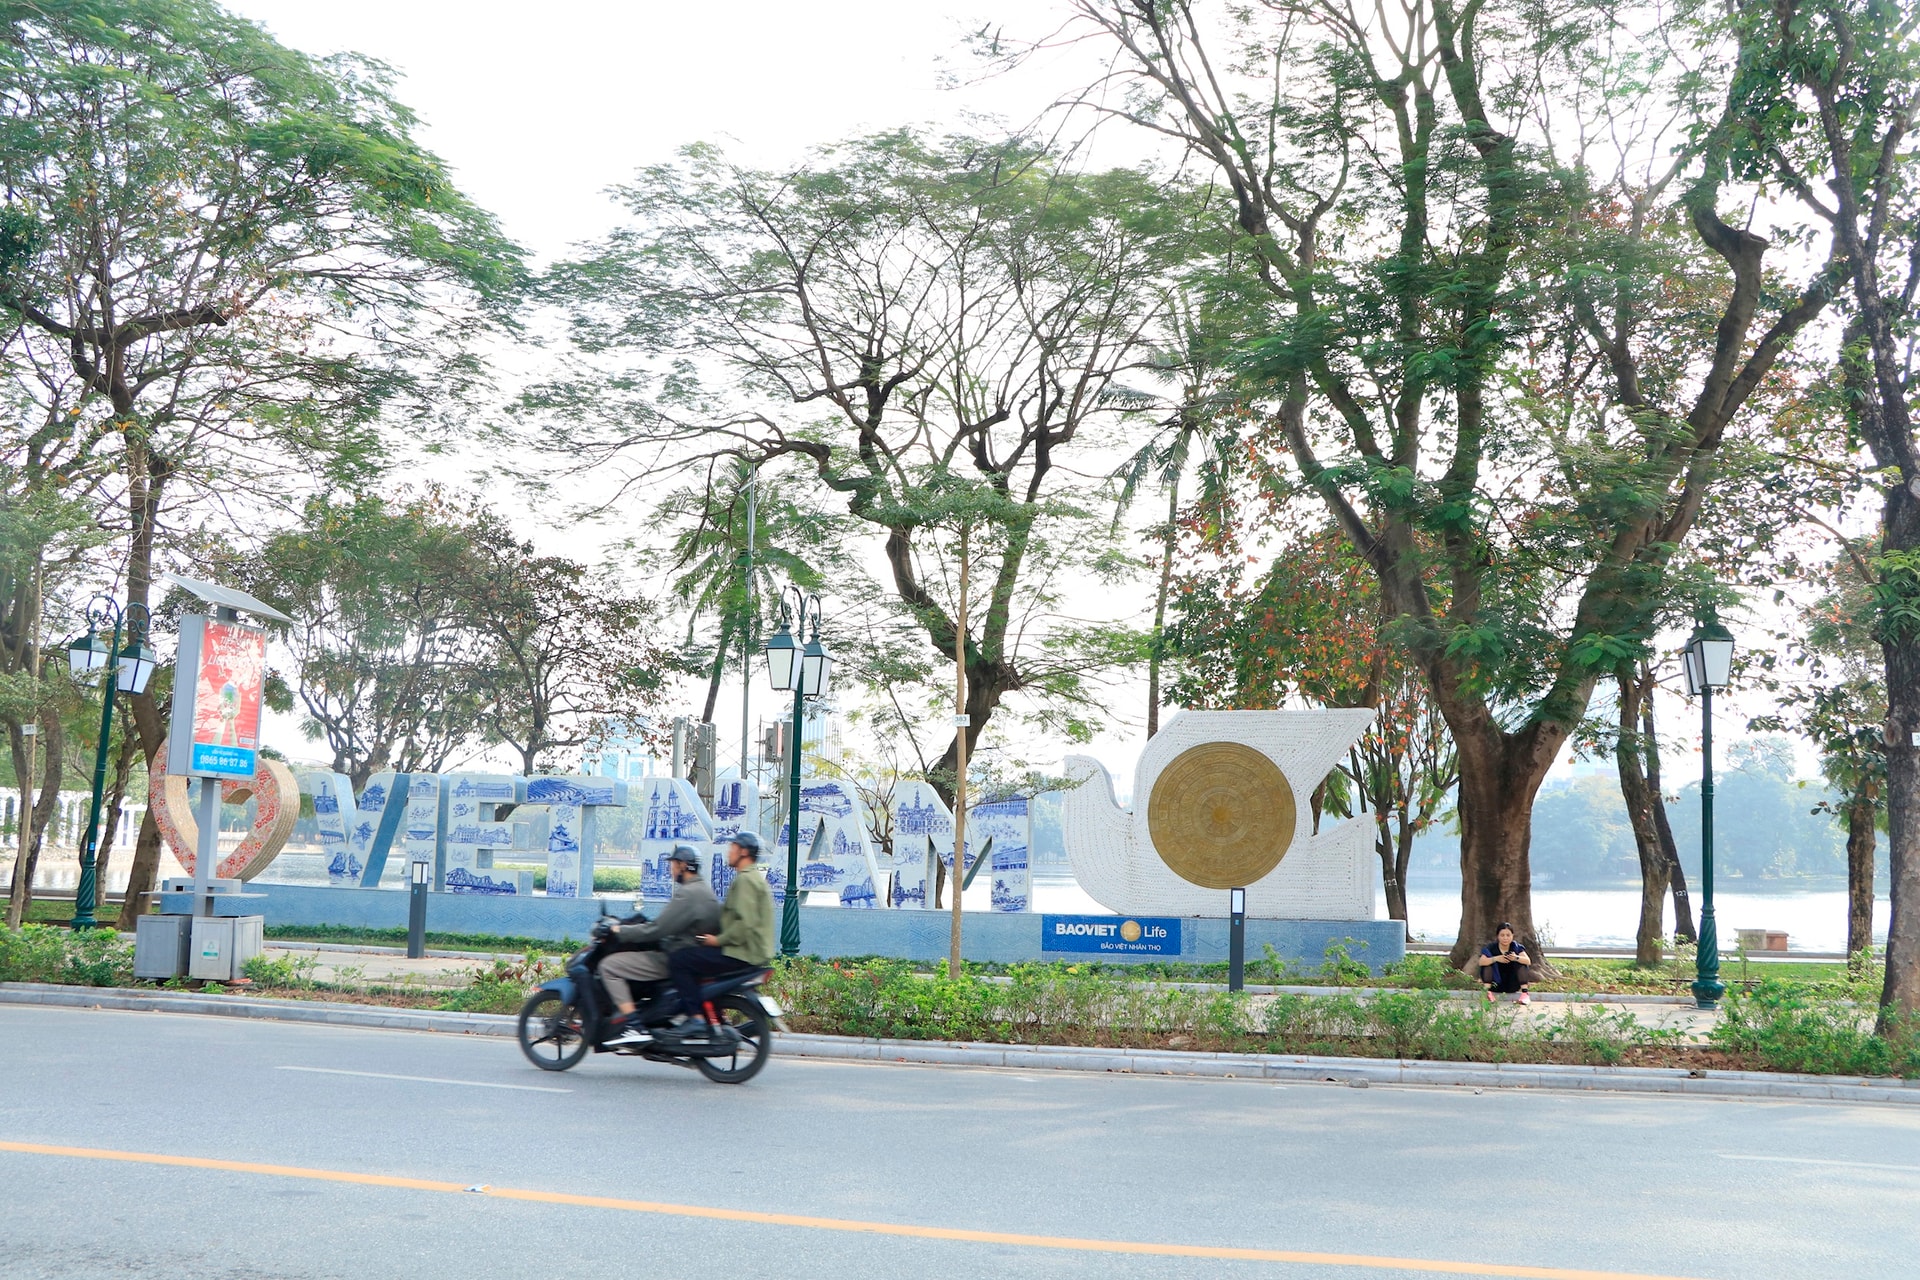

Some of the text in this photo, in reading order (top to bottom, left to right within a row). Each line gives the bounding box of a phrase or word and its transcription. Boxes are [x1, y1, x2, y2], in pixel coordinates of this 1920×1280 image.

[1055, 923, 1167, 938] BAOVIET Life
[1114, 942, 1127, 951] VIỆT
[1128, 942, 1147, 951] NHÂN
[1147, 944, 1161, 952] THỌ
